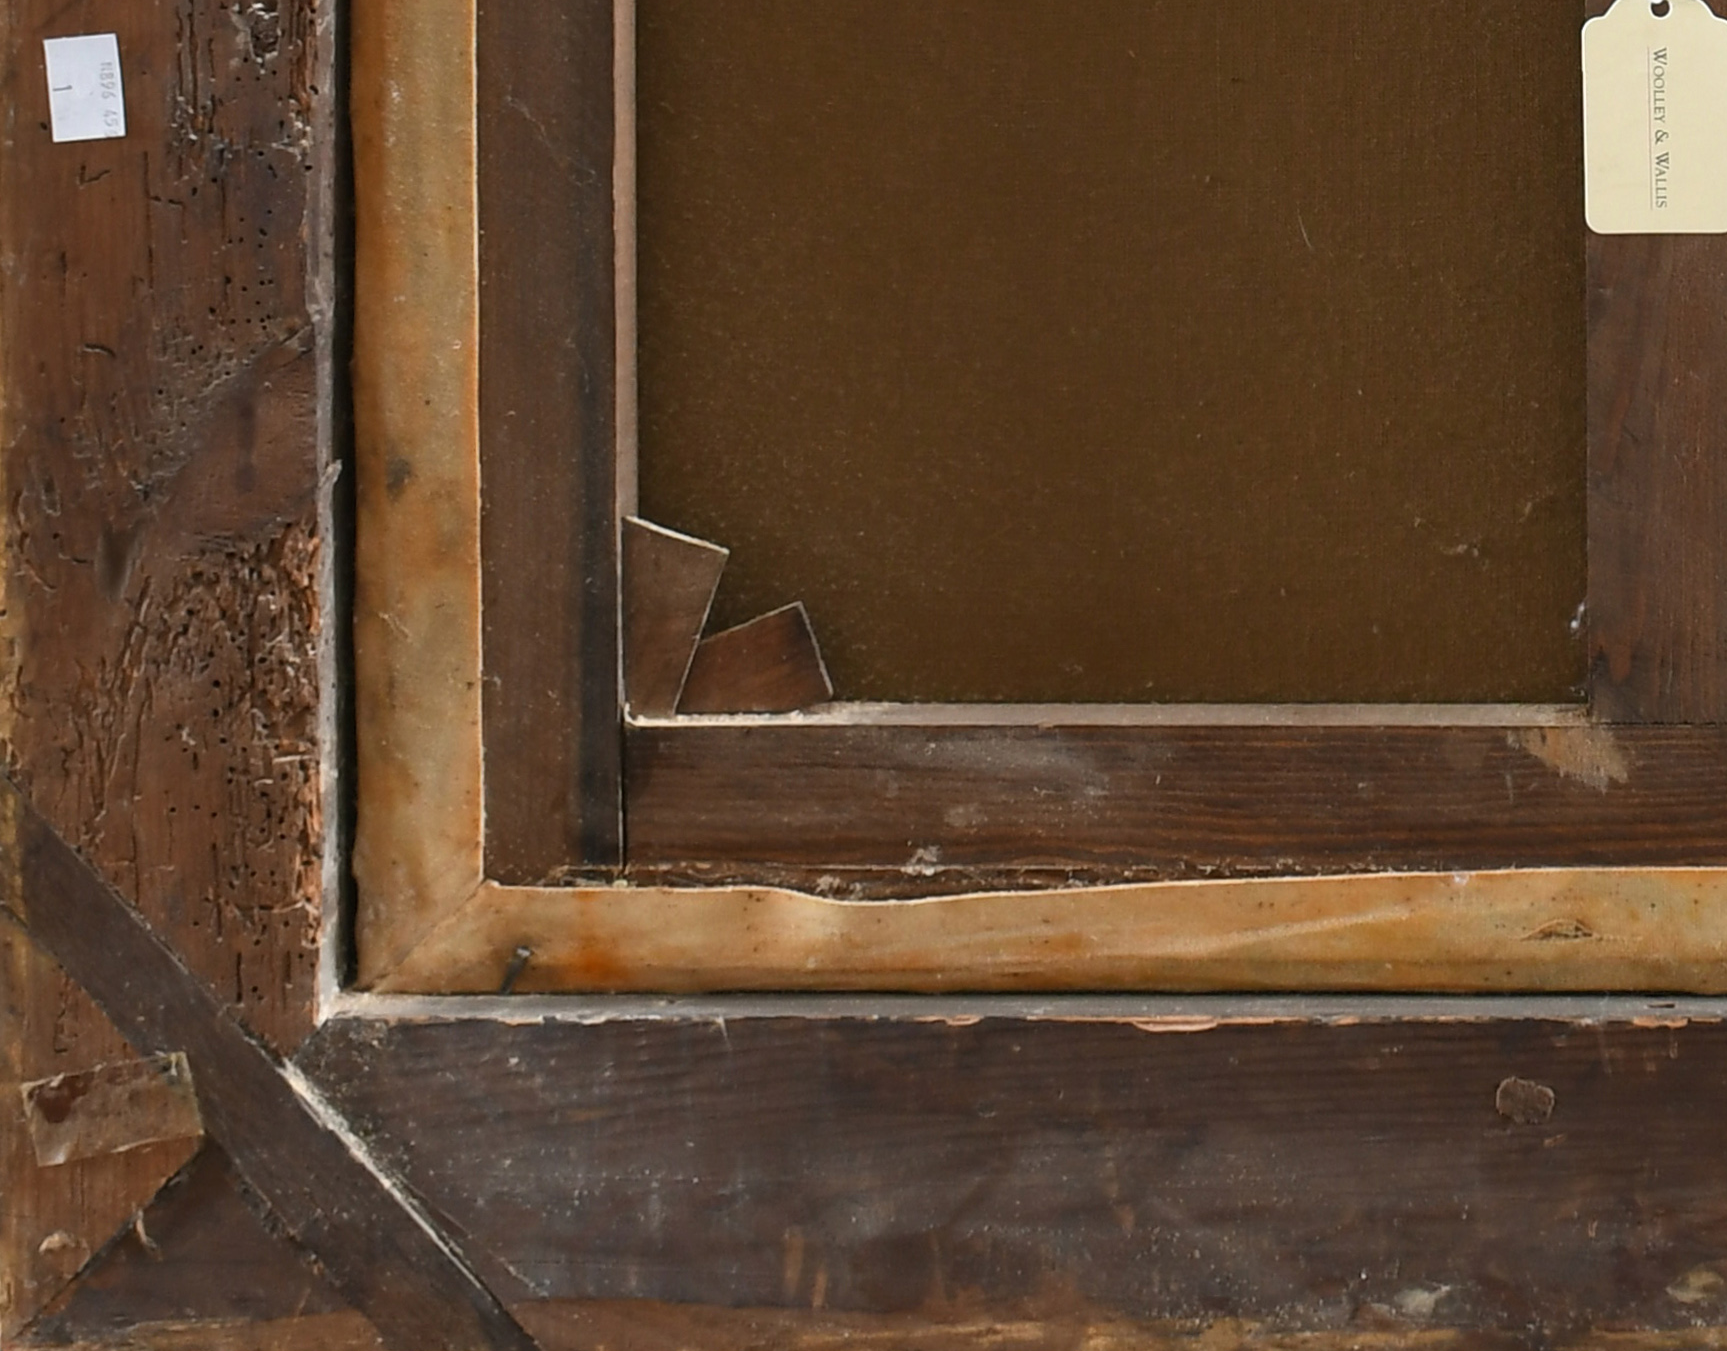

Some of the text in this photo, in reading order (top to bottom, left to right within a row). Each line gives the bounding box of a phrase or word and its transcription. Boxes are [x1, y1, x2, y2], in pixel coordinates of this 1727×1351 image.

[1653, 46, 1670, 209] WOOLLEY & WALLIS
